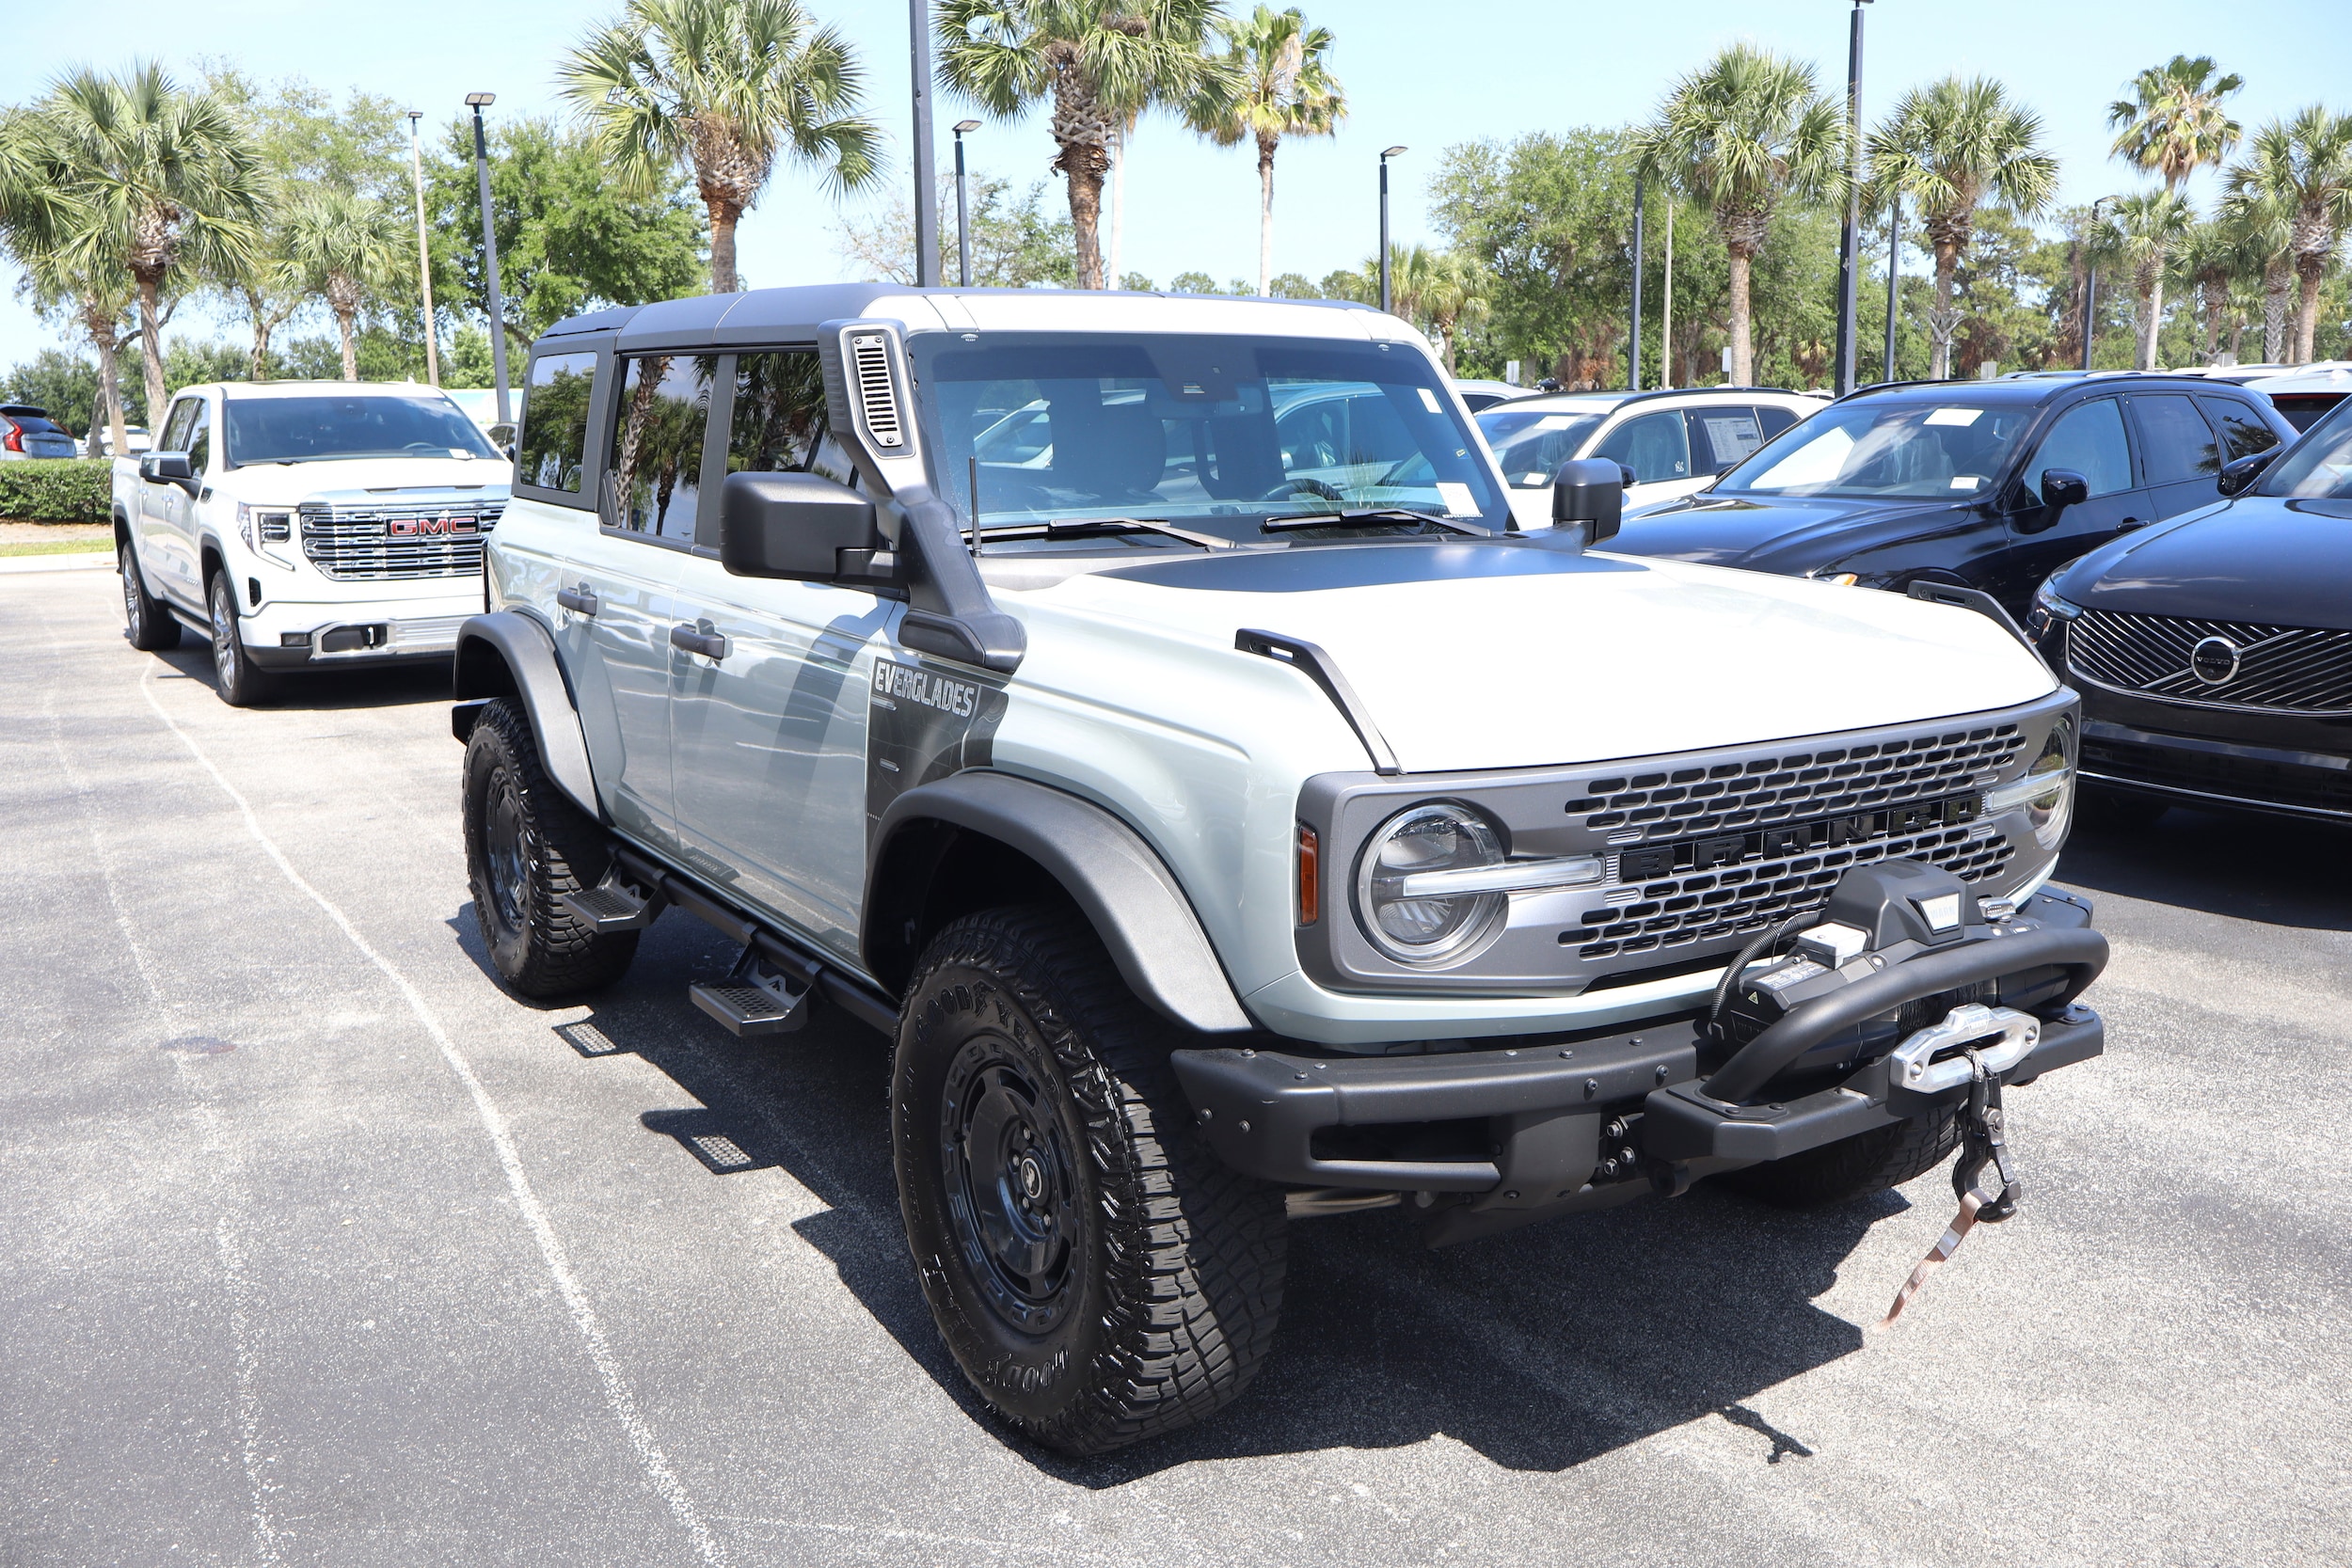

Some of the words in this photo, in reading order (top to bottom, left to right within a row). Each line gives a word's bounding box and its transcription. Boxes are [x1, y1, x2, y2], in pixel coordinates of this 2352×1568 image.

[390, 516, 475, 536] GMC
[2196, 656, 2231, 666] VOLVO
[875, 660, 975, 718] EVERGLADES
[1620, 794, 1982, 882] BRONCO
